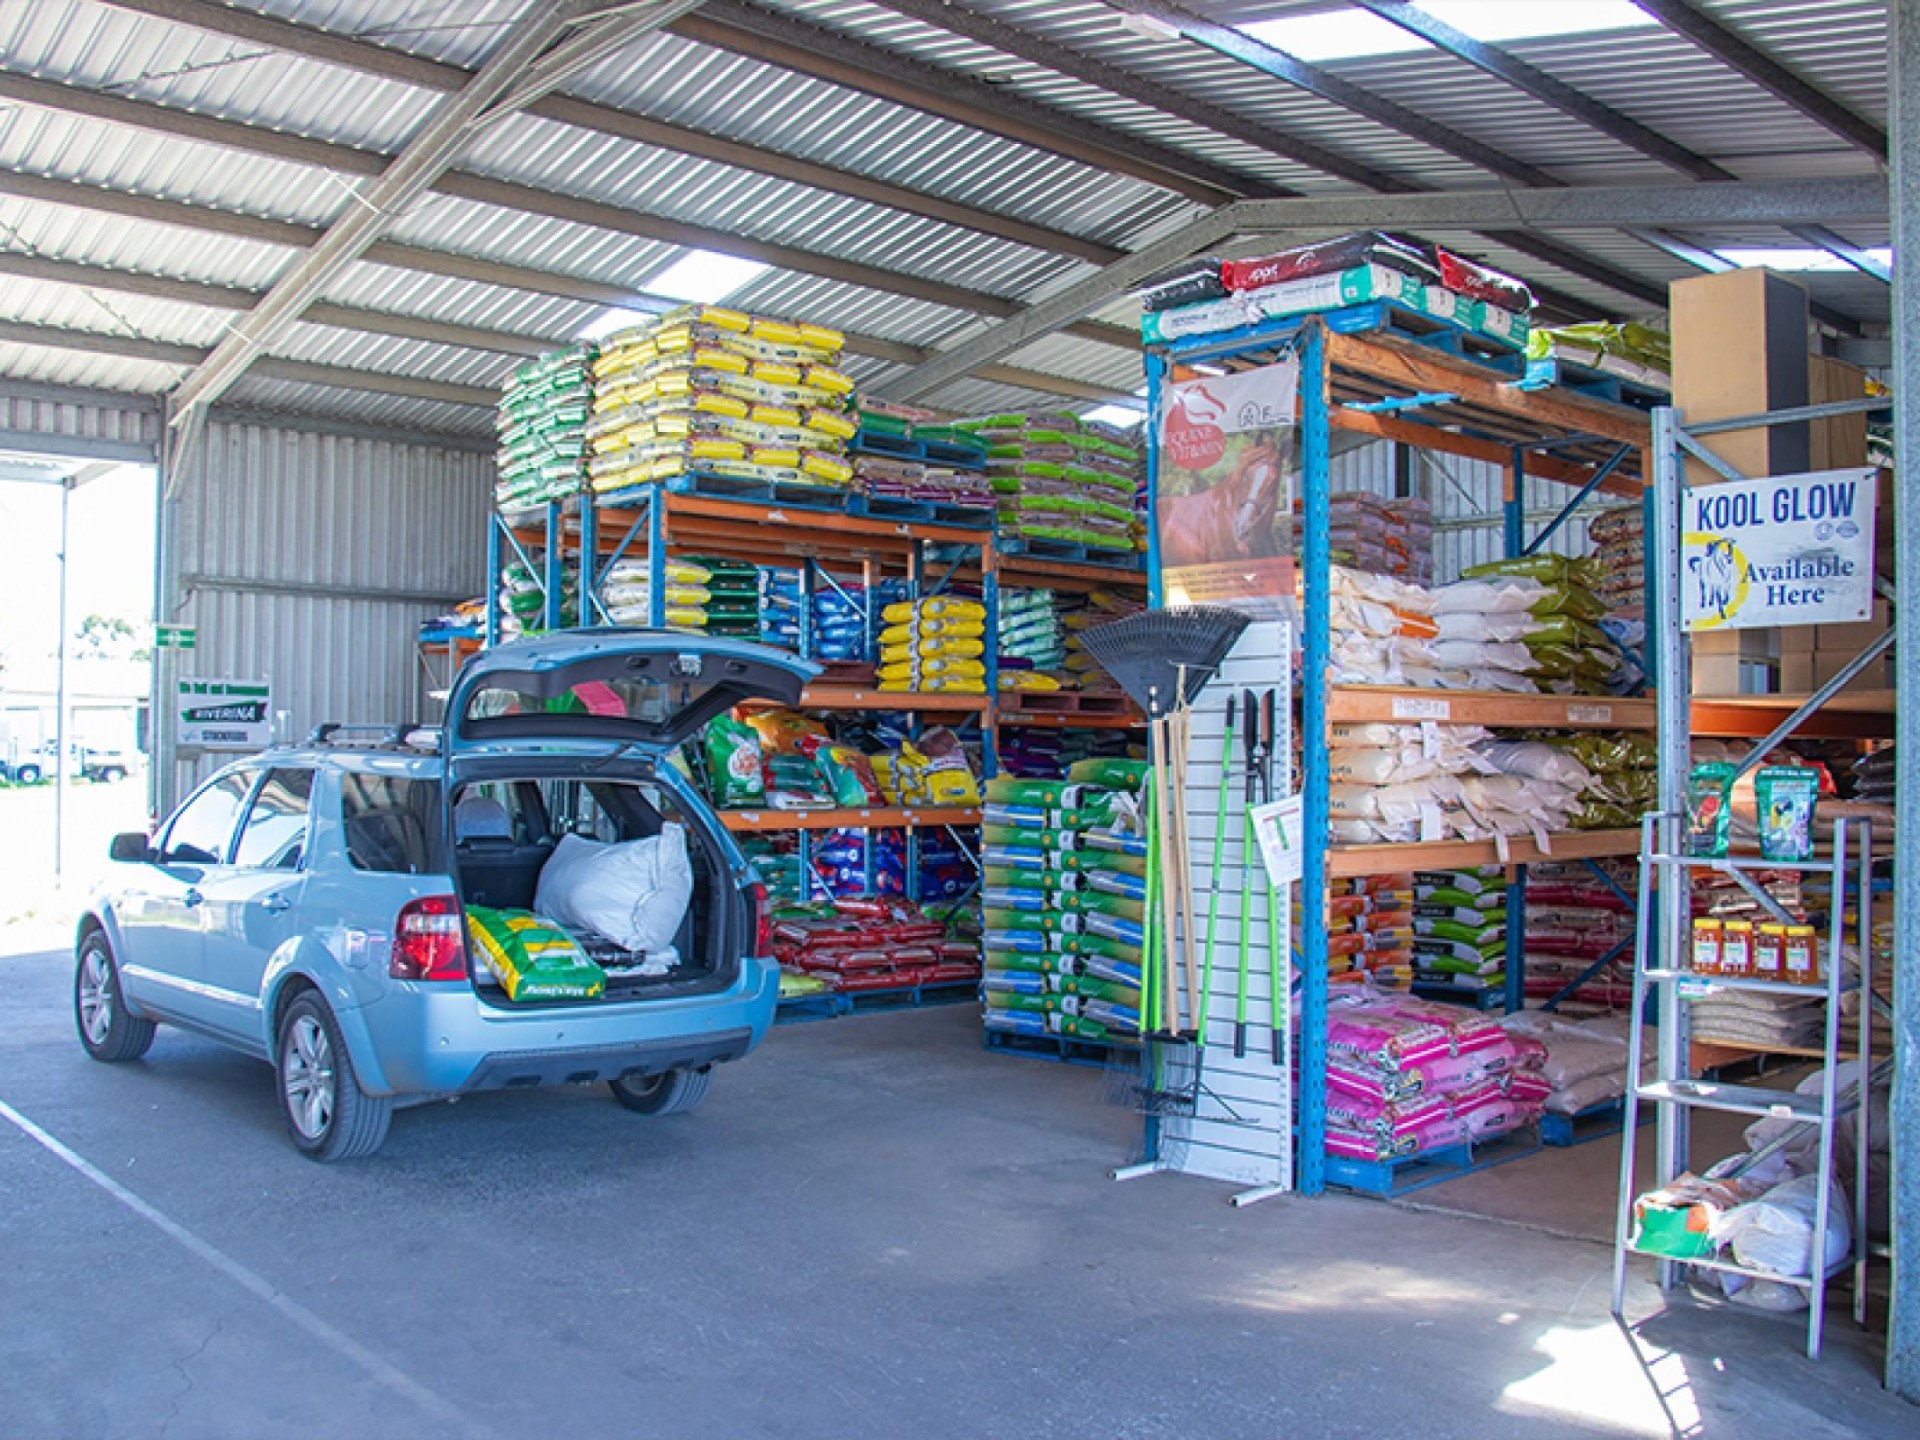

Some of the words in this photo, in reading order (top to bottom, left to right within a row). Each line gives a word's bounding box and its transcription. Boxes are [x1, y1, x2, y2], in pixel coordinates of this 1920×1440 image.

[1697, 491, 1764, 531] KOOL
[1773, 481, 1856, 523] GLOW
[1742, 554, 1854, 583] Available
[1767, 585, 1825, 606] Here
[195, 705, 256, 720] RIVERINA
